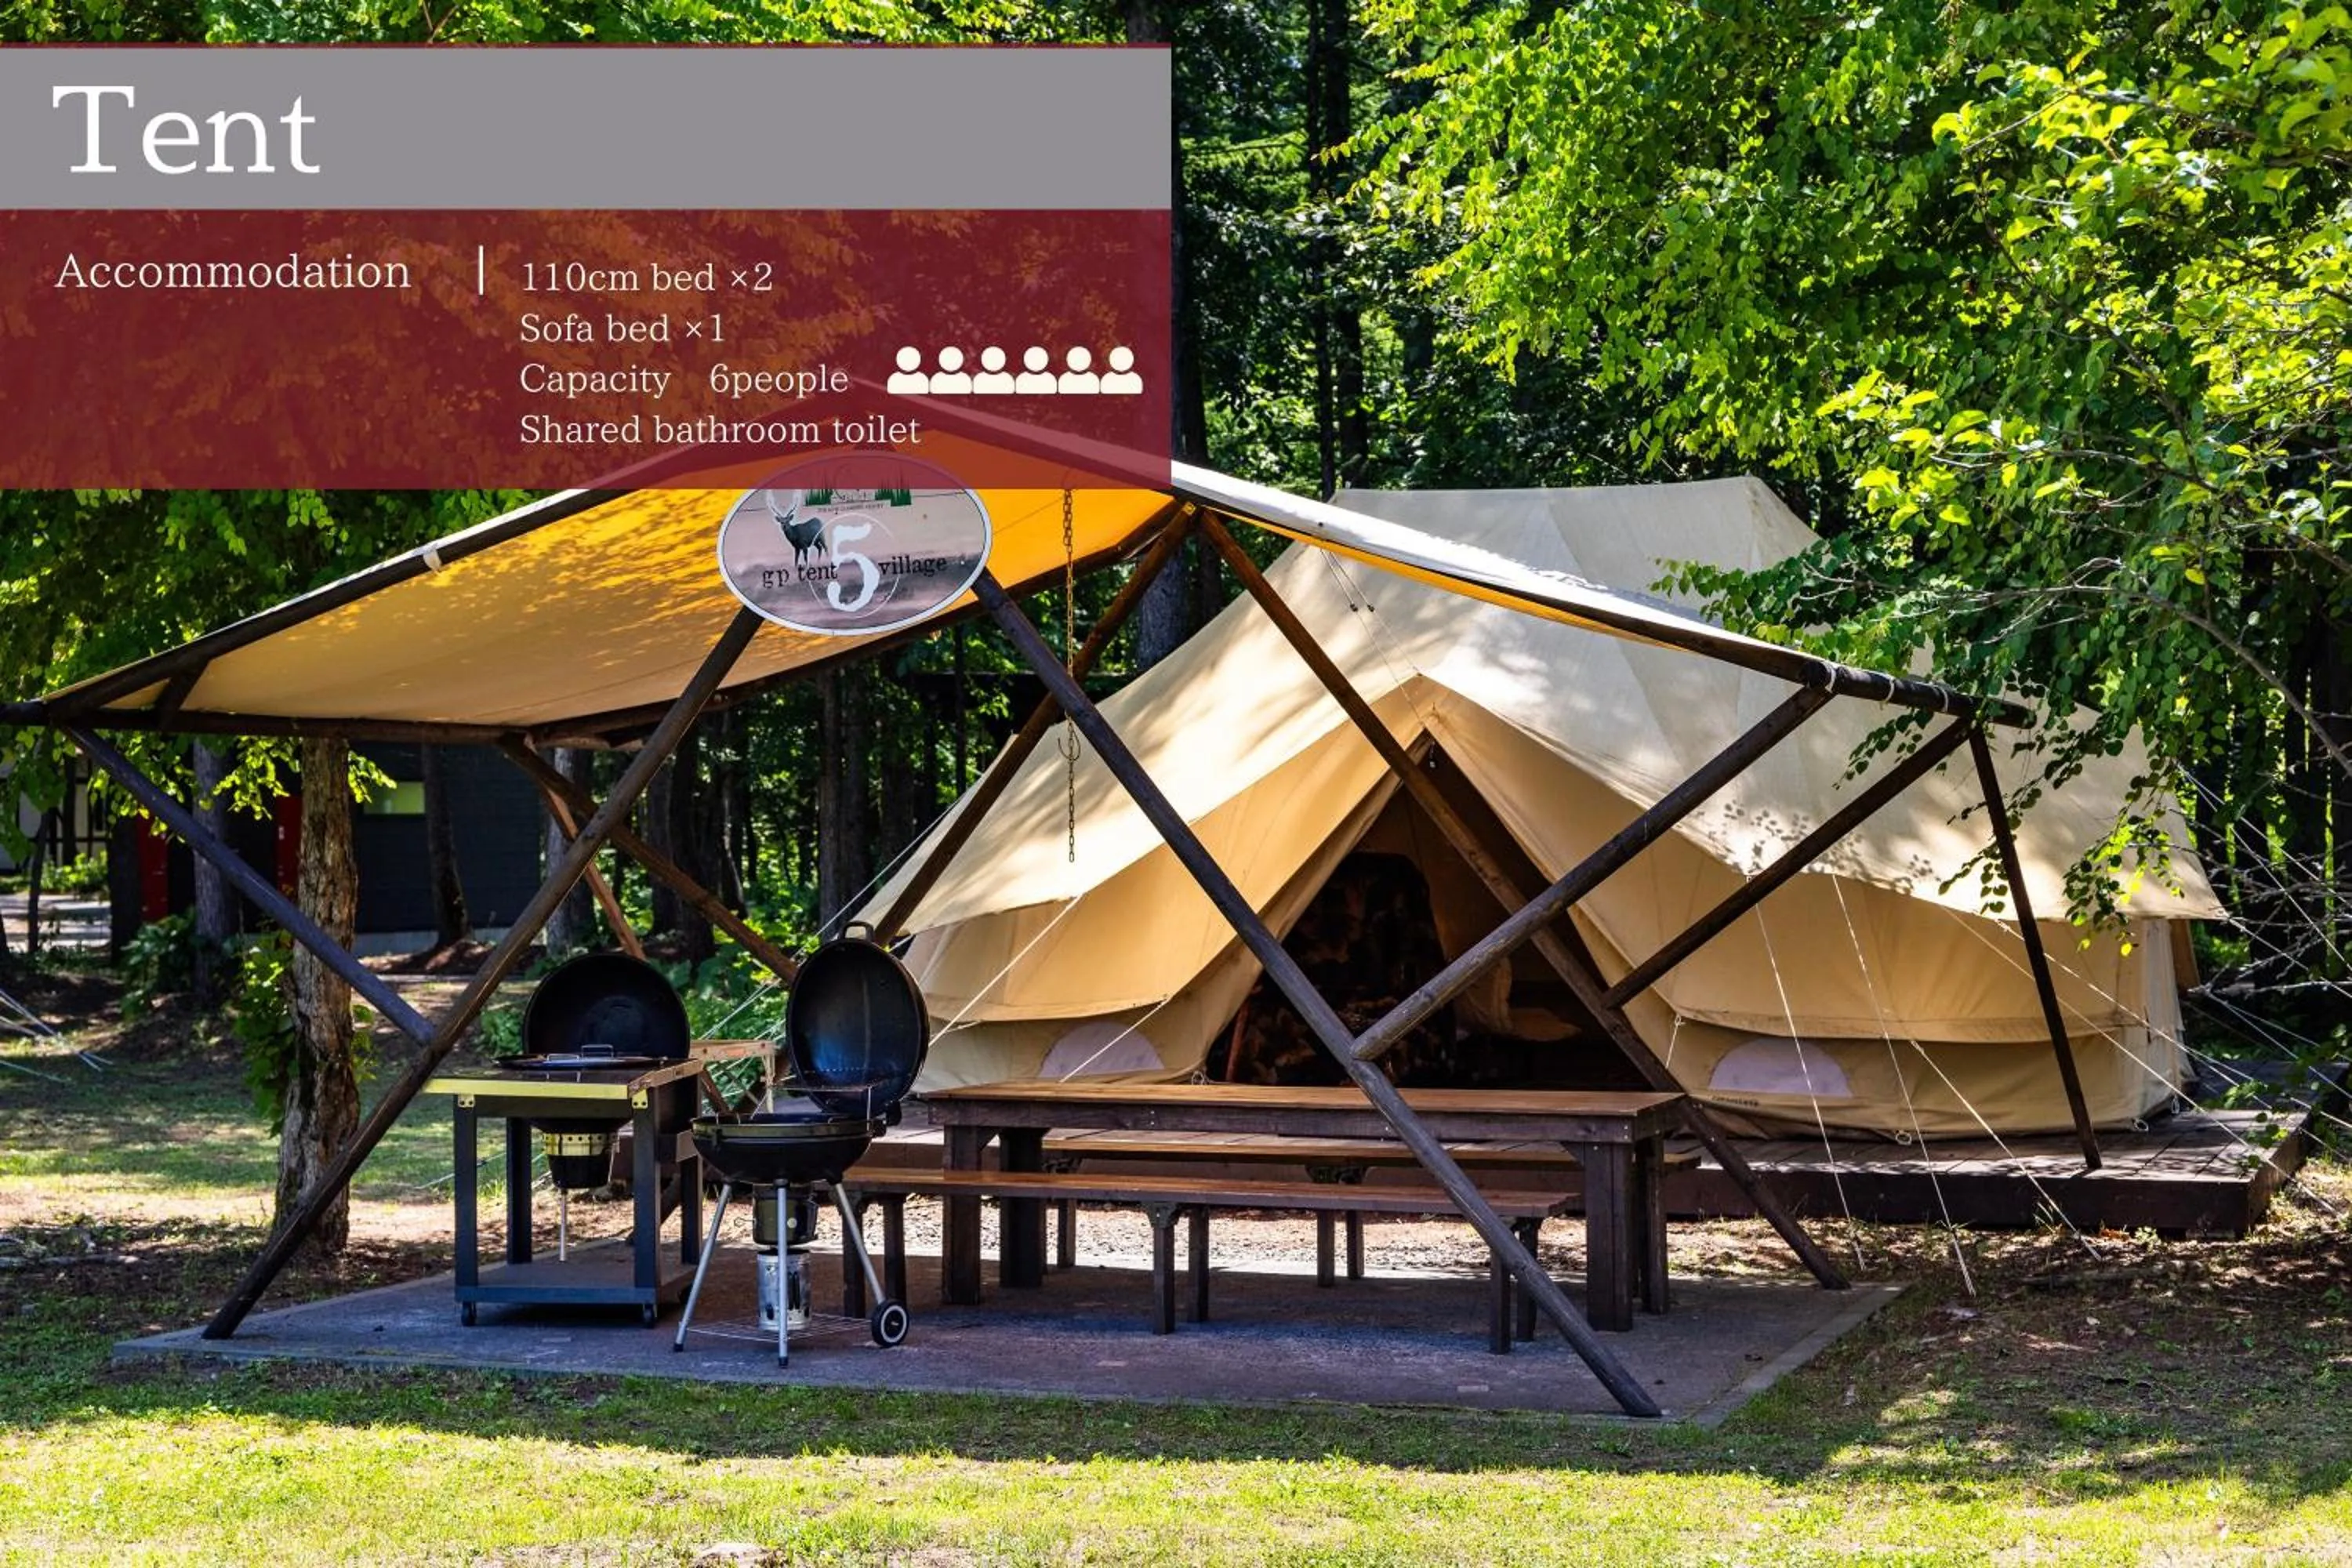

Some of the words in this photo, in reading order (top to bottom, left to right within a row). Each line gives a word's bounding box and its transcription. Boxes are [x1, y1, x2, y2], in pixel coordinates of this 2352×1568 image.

[762, 568, 789, 588] gp
[797, 561, 838, 582] tent
[827, 523, 880, 612] 5
[878, 555, 947, 577] village
